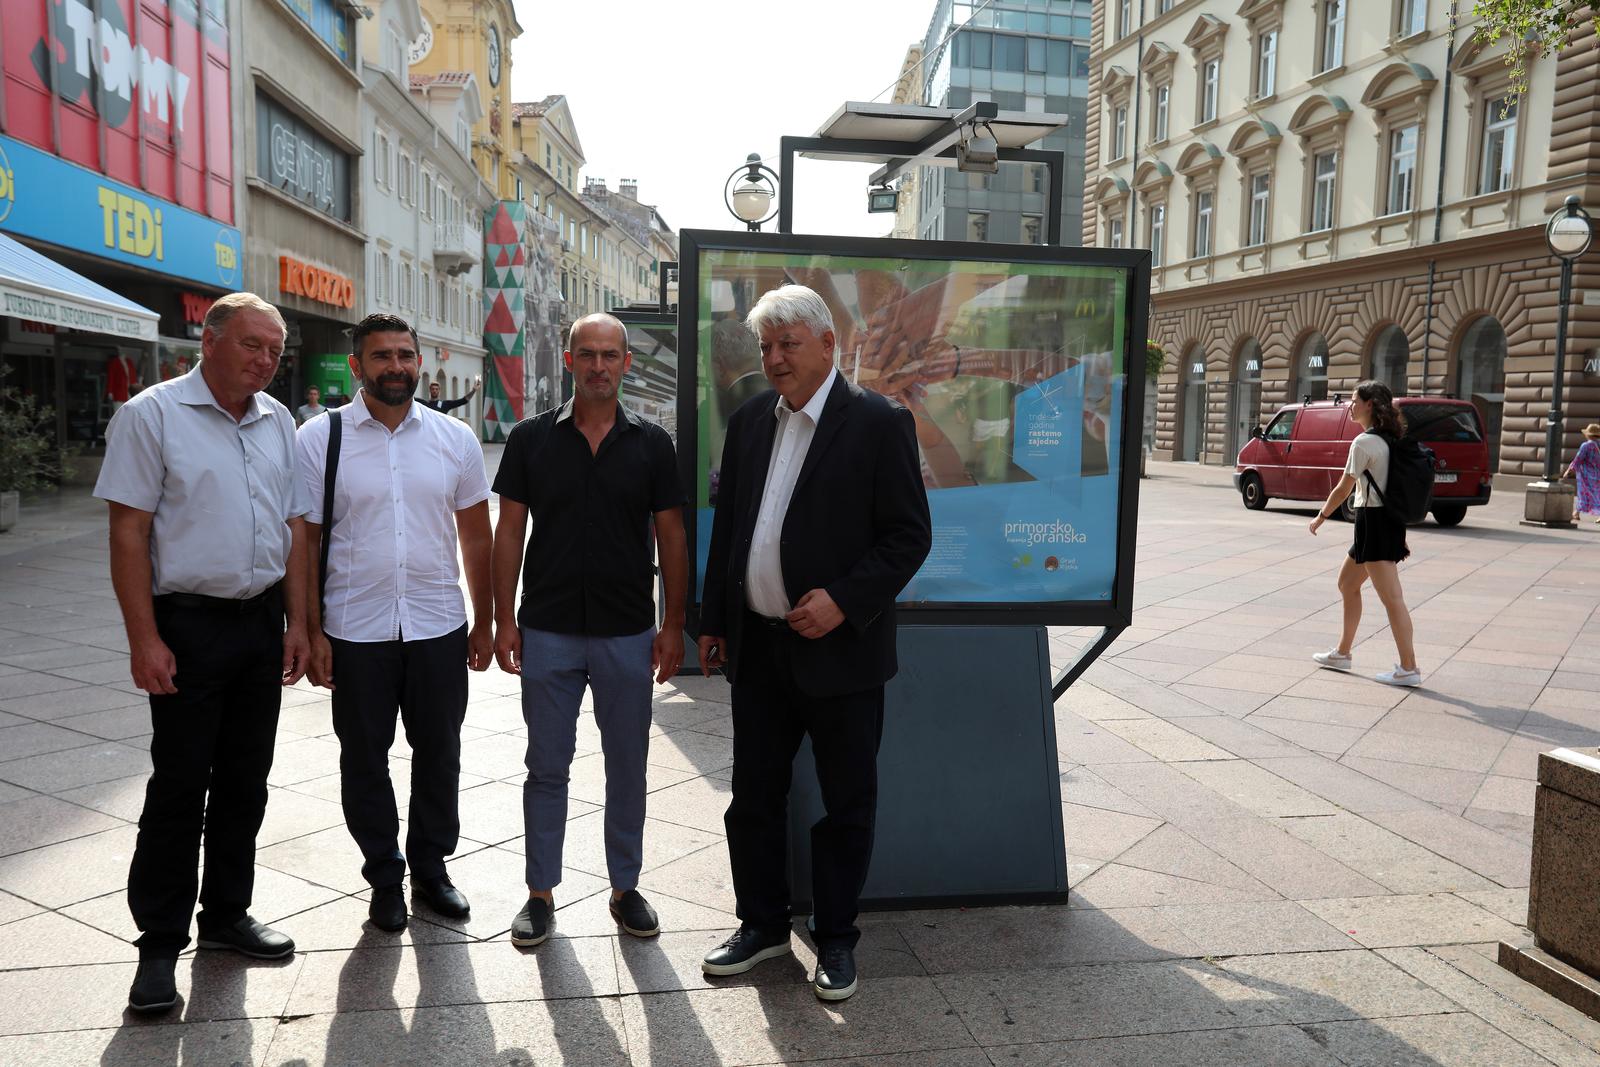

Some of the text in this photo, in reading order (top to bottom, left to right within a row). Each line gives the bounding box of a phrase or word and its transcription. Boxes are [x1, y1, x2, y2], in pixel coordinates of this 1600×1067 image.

[65, 0, 191, 132] TOMMY
[271, 123, 335, 208] CENTRA
[98, 185, 164, 262] TEDi
[215, 241, 237, 270] TEDi
[279, 255, 355, 309] KORZO
[1028, 429, 1062, 437] rastemo
[1028, 438, 1060, 447] zajedno
[1005, 518, 1072, 538] primorsko
[1026, 528, 1086, 547] goranska
